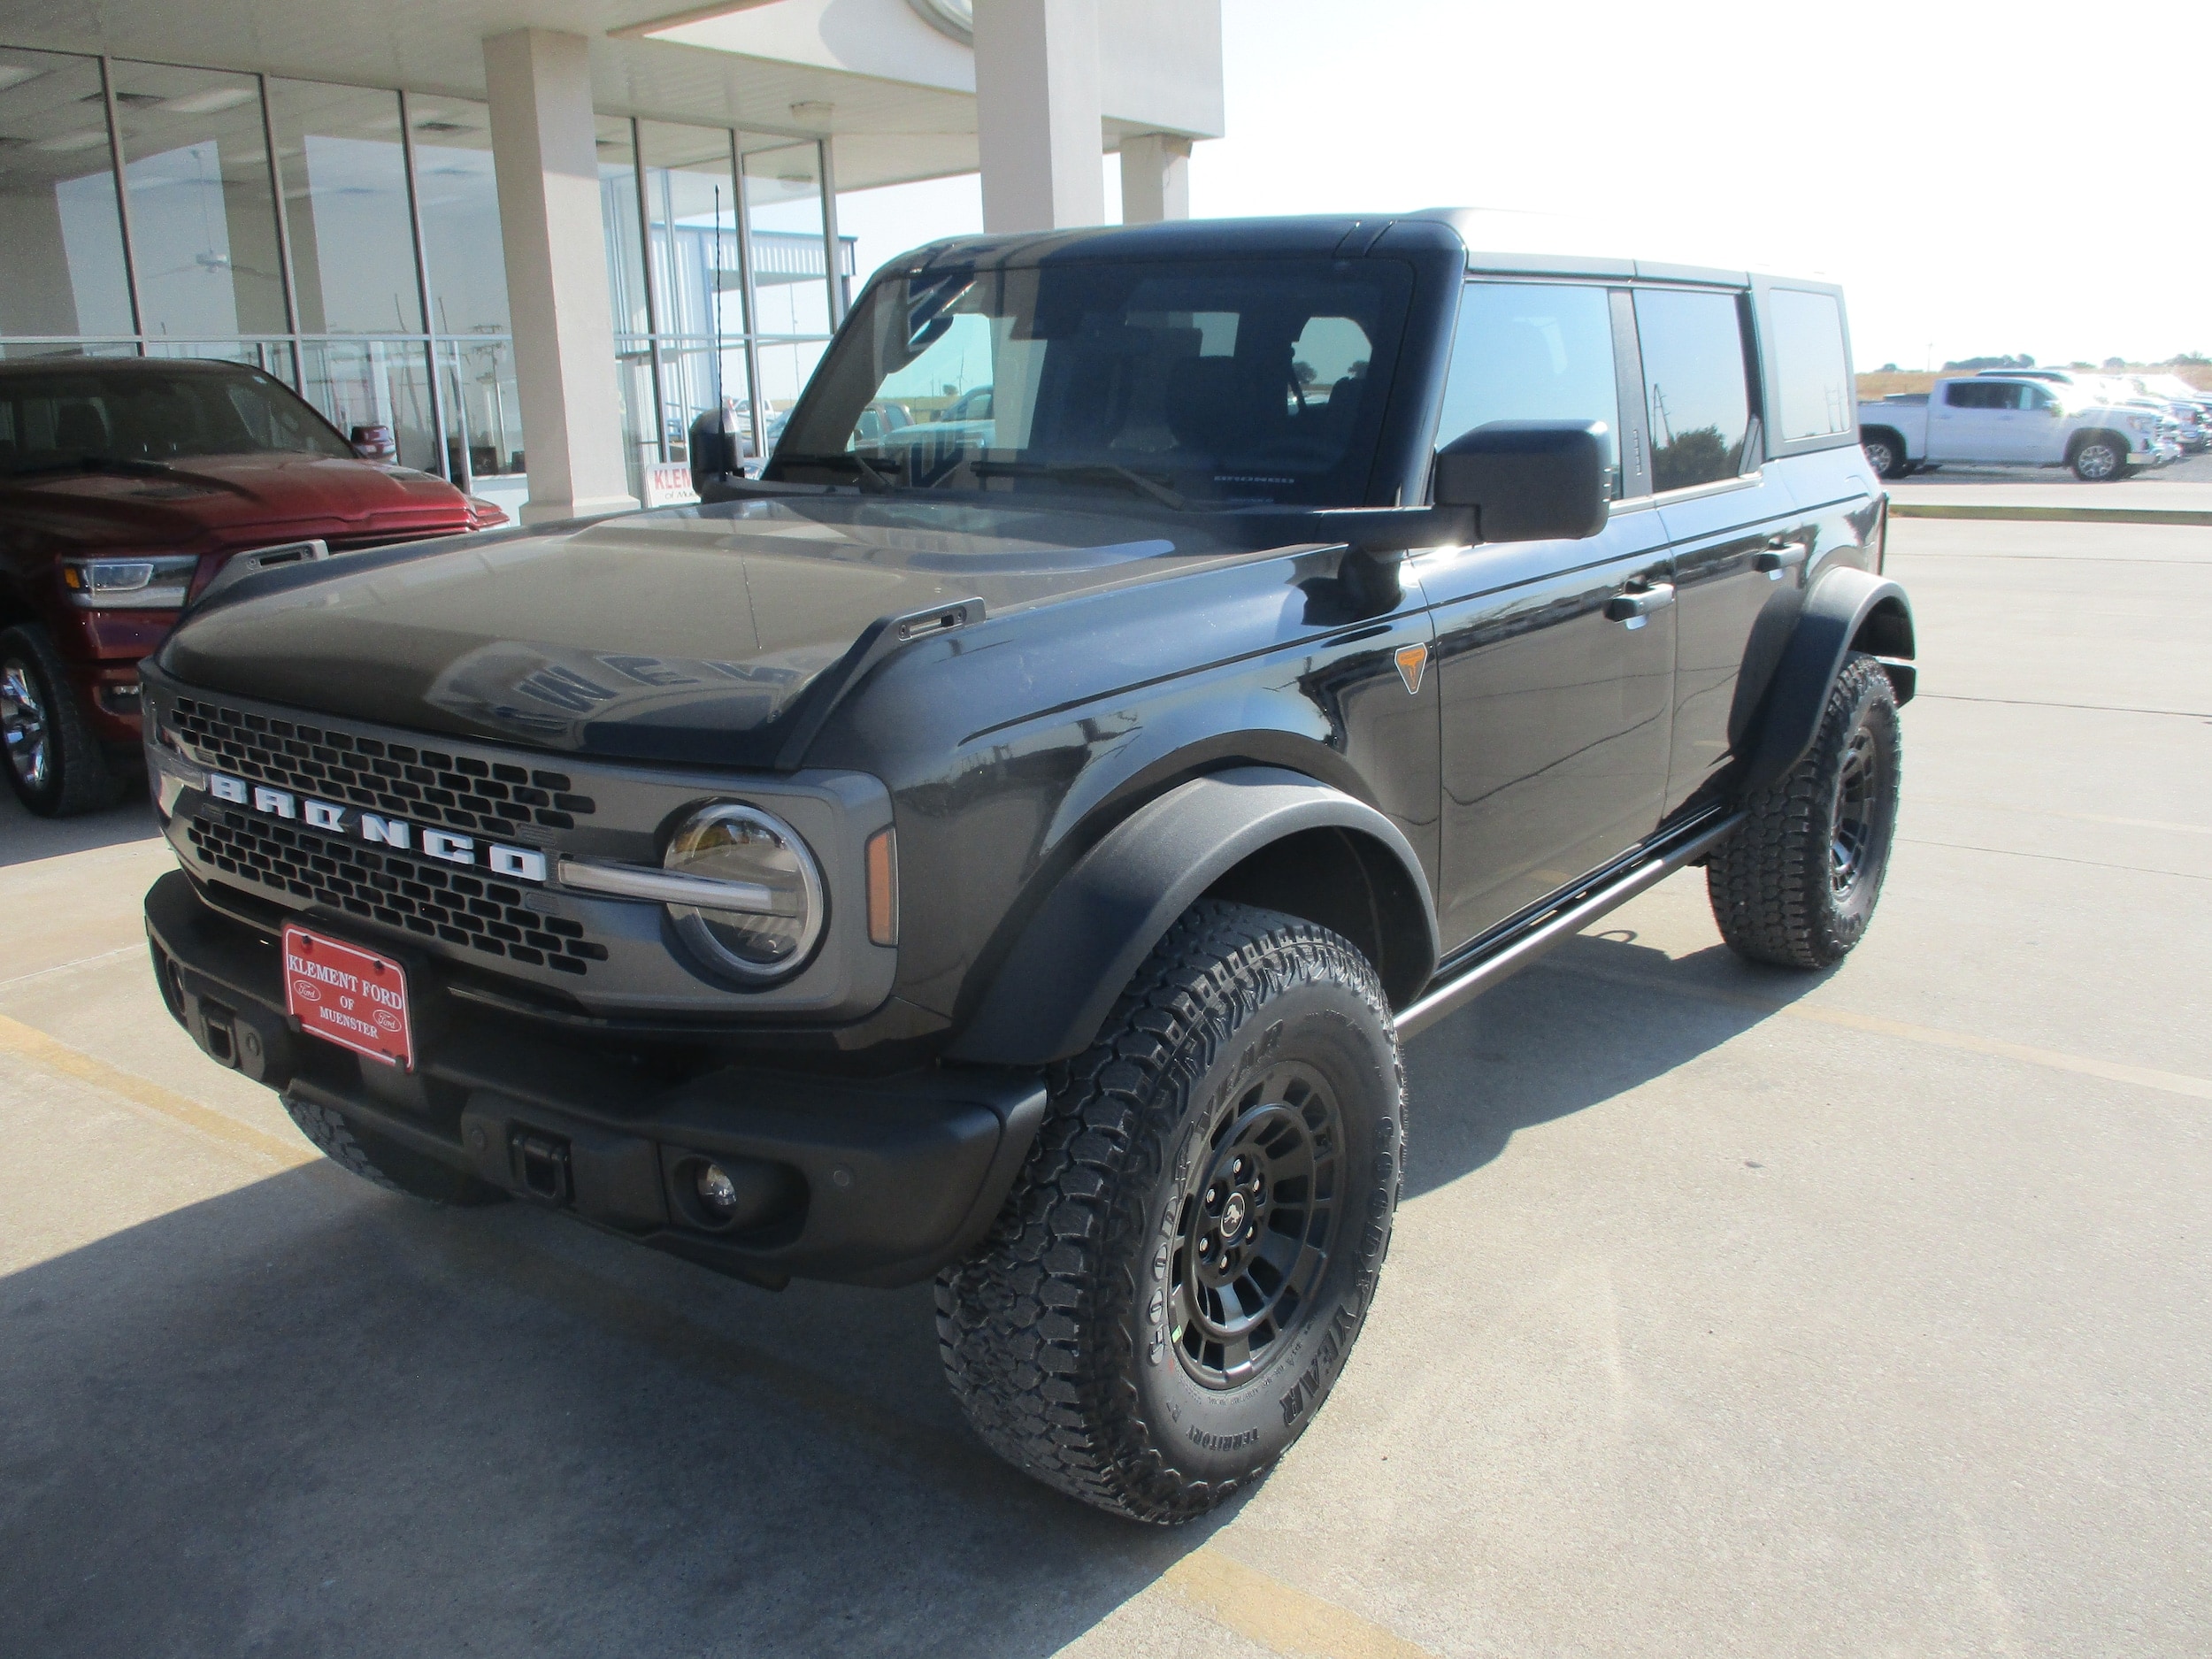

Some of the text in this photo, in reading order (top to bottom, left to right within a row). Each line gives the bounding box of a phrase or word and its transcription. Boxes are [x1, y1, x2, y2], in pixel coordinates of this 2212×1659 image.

[211, 772, 547, 881] BRONCO
[288, 954, 403, 1010] KLEMENT FORD
[340, 995, 354, 1010] OF
[319, 1006, 379, 1039] MUENSTER
[1186, 1425, 1259, 1451] TERRITORY
